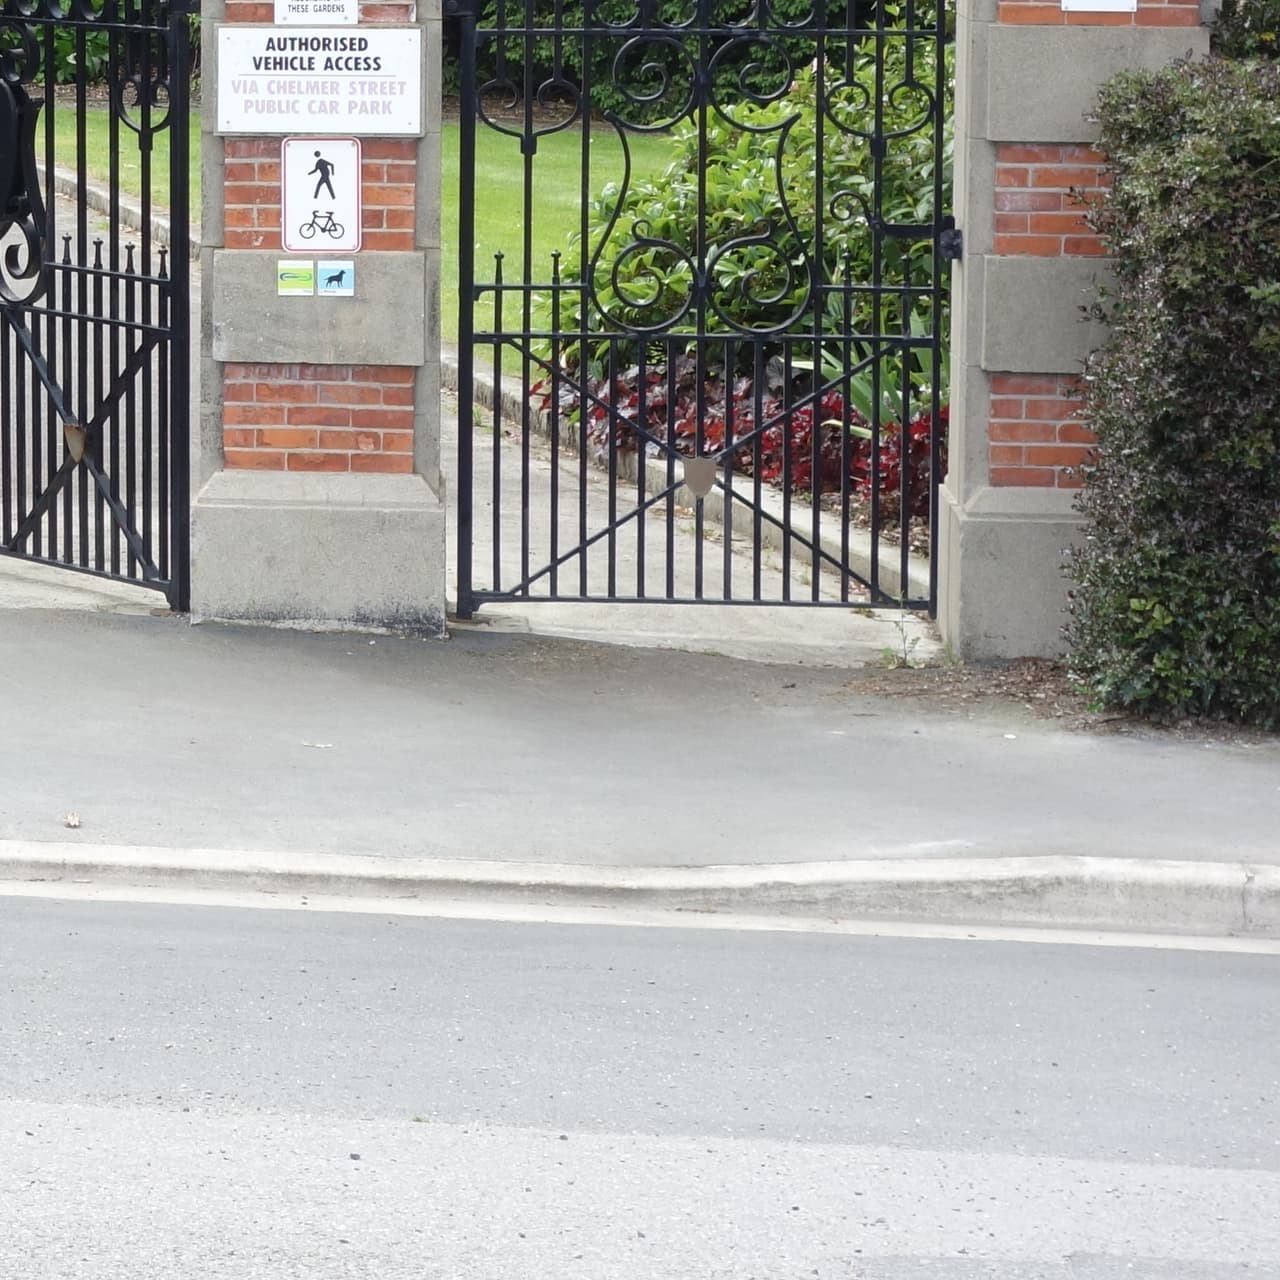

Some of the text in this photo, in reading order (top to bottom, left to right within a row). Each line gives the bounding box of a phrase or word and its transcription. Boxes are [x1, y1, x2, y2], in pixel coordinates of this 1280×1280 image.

[288, 4, 345, 13] THESE GARDENS
[266, 36, 369, 52] AUTHORISED
[252, 56, 382, 71] VEHICLE ACCESS
[231, 79, 407, 96] VIA CHELMER STREET
[243, 99, 393, 115] PUBLIC CAR PARK
